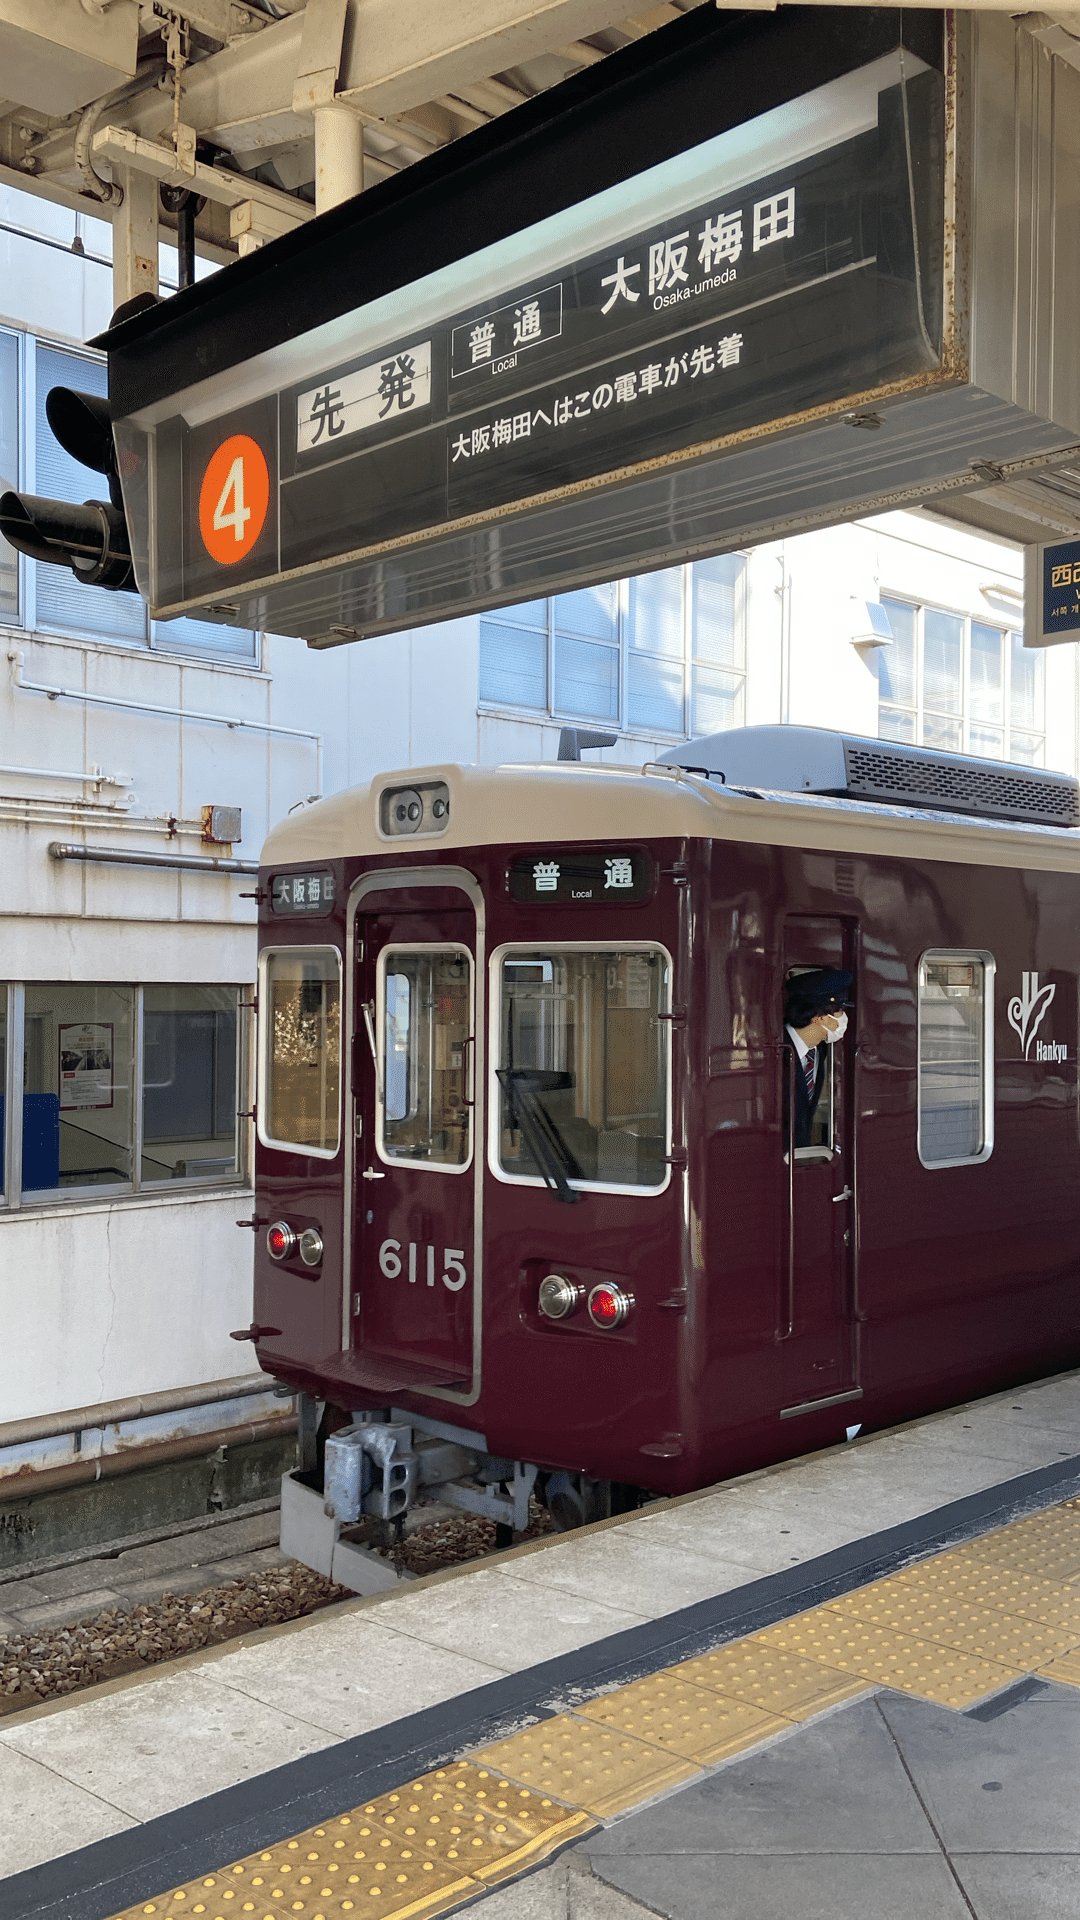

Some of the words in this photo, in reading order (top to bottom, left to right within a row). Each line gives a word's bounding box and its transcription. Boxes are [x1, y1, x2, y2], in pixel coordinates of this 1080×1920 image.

[600, 187, 796, 315] 大阪梅田
[653, 268, 738, 311] Osaka-umeda
[468, 301, 542, 364] 普通
[491, 353, 518, 375] Local
[310, 354, 416, 445] 先発
[451, 332, 744, 463] 大阪梅田へはこの電車が先着
[212, 456, 252, 542] 4
[532, 858, 634, 892] 普通
[571, 890, 593, 899] Local
[1036, 1039, 1068, 1064] Hankyu
[378, 1238, 467, 1292] 6115
